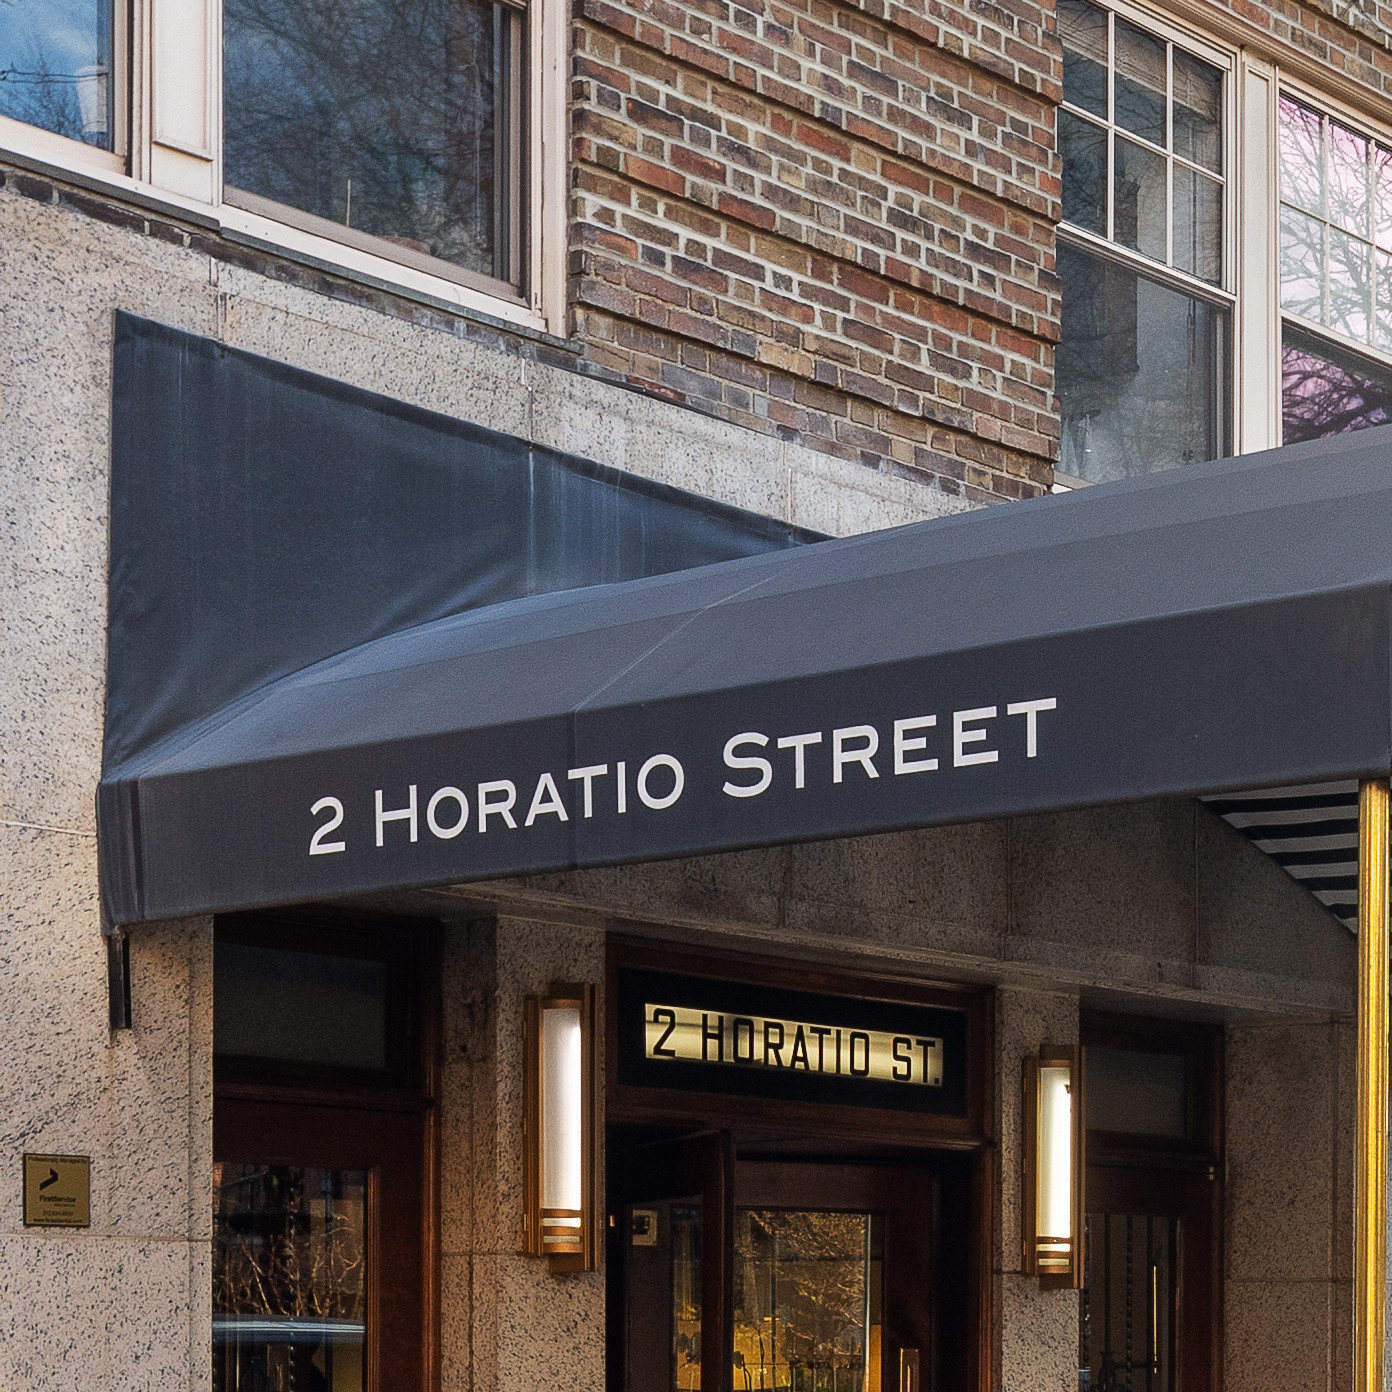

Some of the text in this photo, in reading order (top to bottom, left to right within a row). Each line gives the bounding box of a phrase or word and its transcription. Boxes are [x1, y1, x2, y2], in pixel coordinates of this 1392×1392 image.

[308, 697, 1057, 856] 2 HORATIO STREET
[652, 1008, 940, 1084] 2 HORATIO ST.
